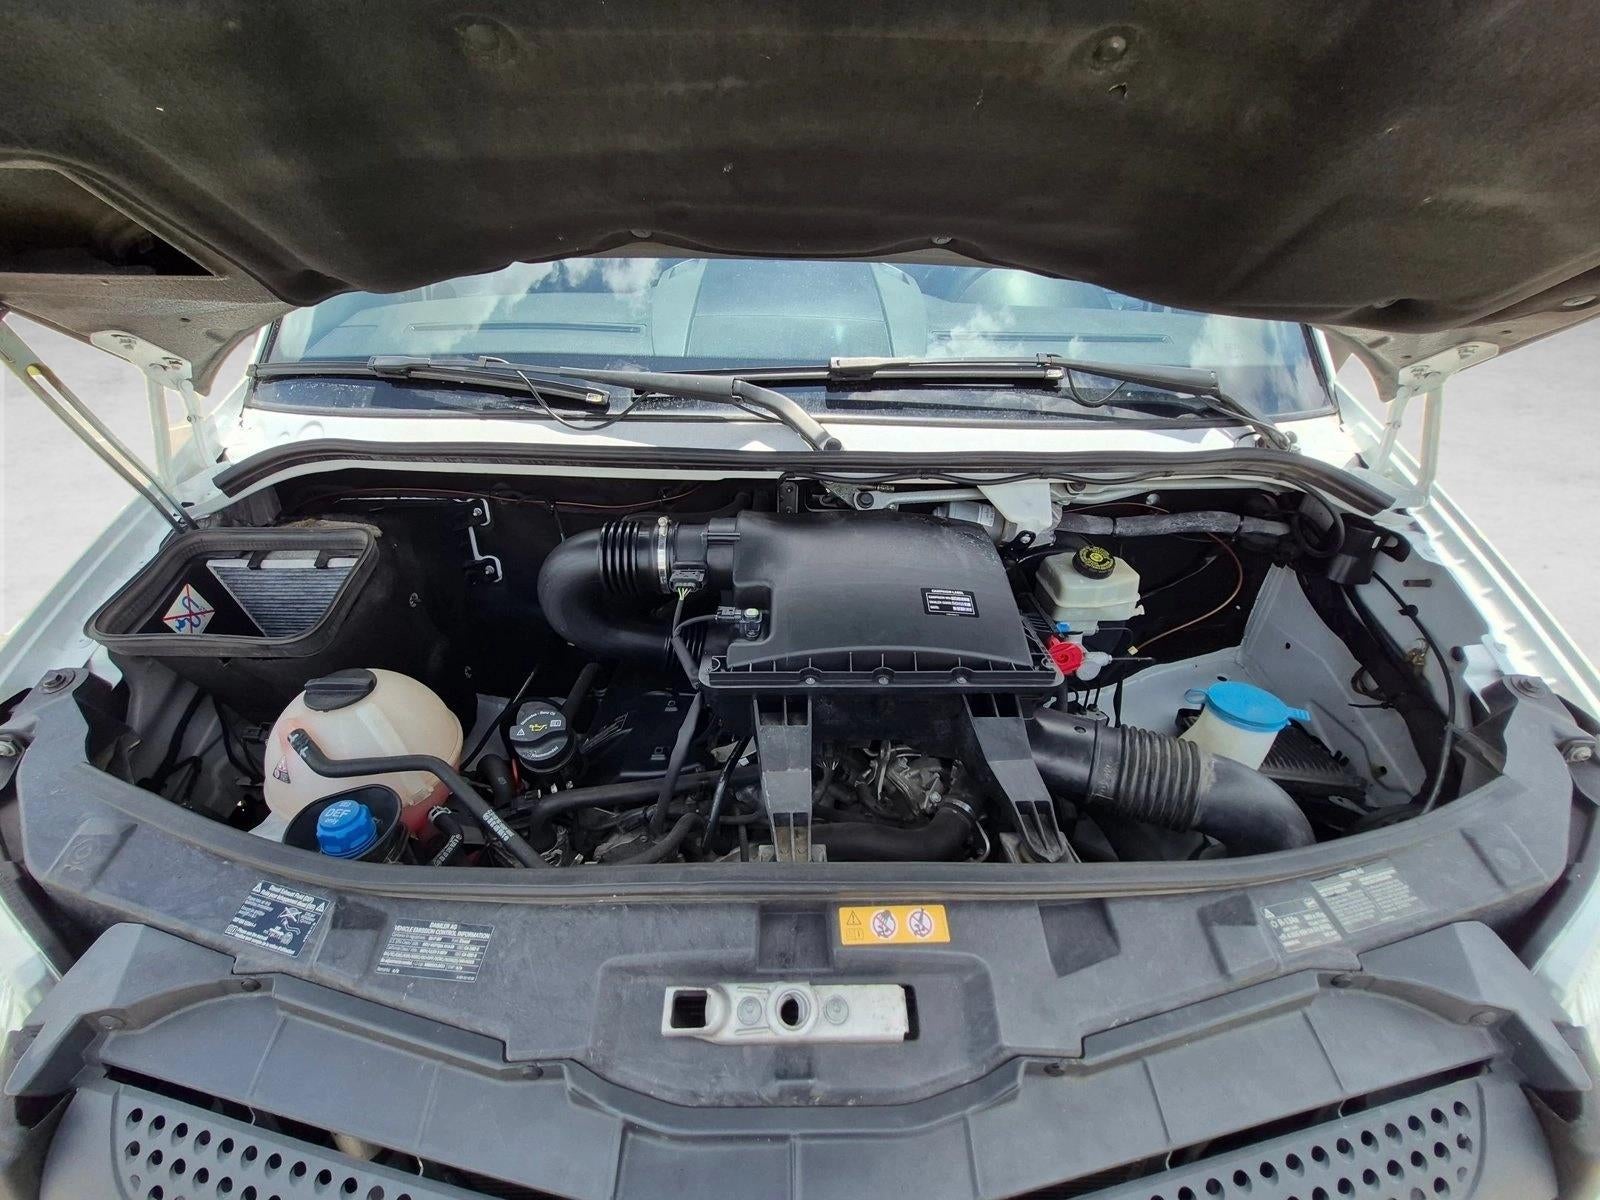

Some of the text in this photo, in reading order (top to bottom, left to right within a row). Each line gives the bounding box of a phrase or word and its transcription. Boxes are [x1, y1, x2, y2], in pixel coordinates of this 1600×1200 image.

[325, 808, 352, 818] DEF
[324, 817, 340, 825] only
[412, 926, 436, 934] EMISSION
